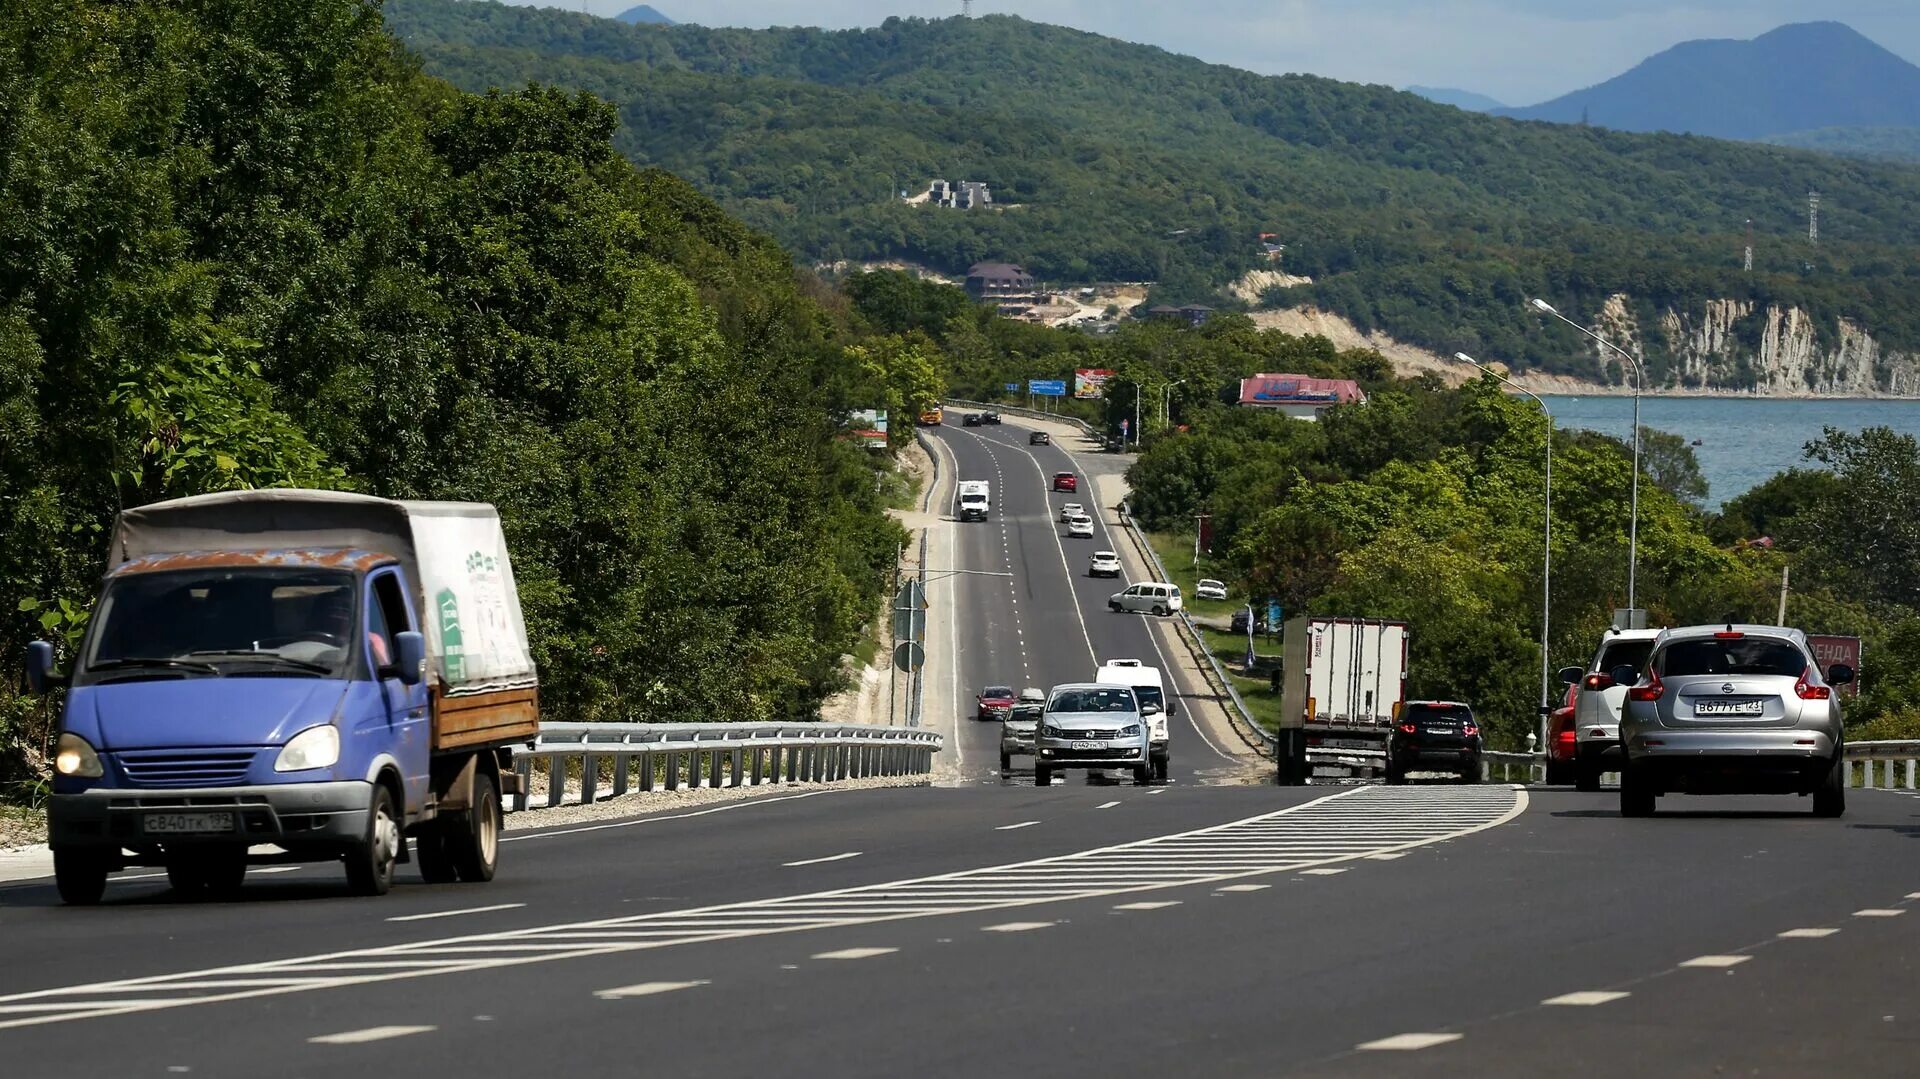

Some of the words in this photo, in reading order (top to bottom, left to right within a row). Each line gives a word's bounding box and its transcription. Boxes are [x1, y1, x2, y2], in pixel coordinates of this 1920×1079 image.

[1699, 701, 1741, 712] В677УЕ
[1745, 700, 1759, 709] 123
[148, 815, 203, 830] С840ТК
